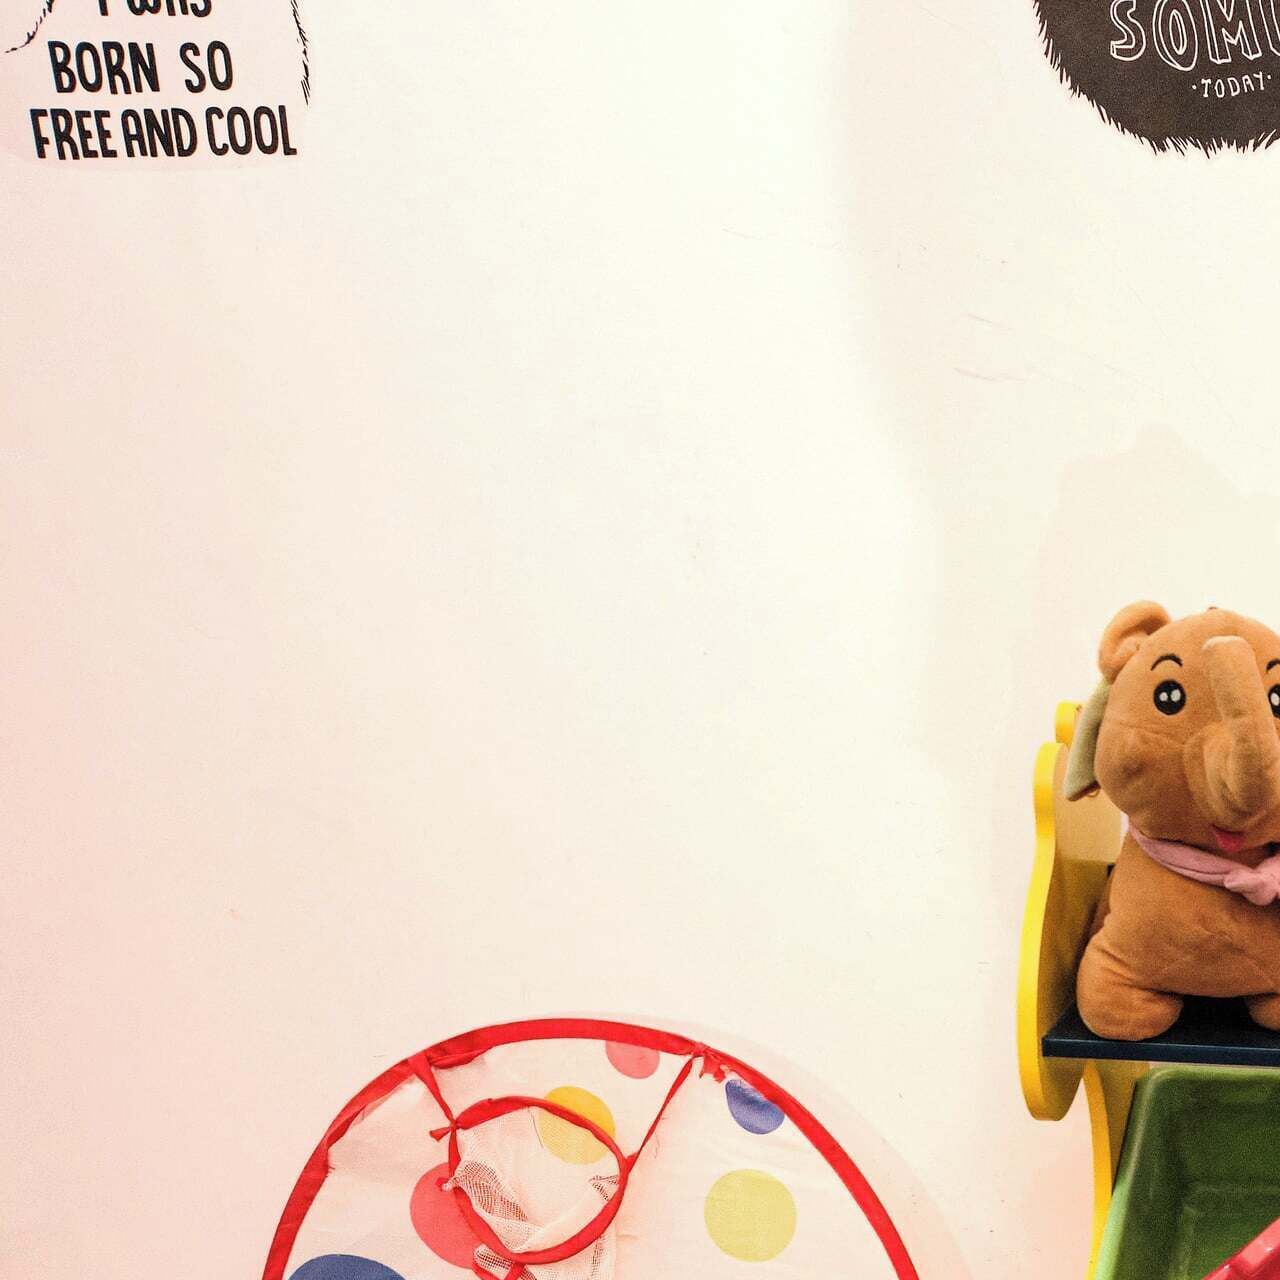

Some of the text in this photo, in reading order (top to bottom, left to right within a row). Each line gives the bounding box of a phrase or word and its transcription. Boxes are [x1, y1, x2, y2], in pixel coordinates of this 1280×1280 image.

[47, 40, 234, 95] BORN SO
[29, 104, 298, 161] FREE AND COOL
